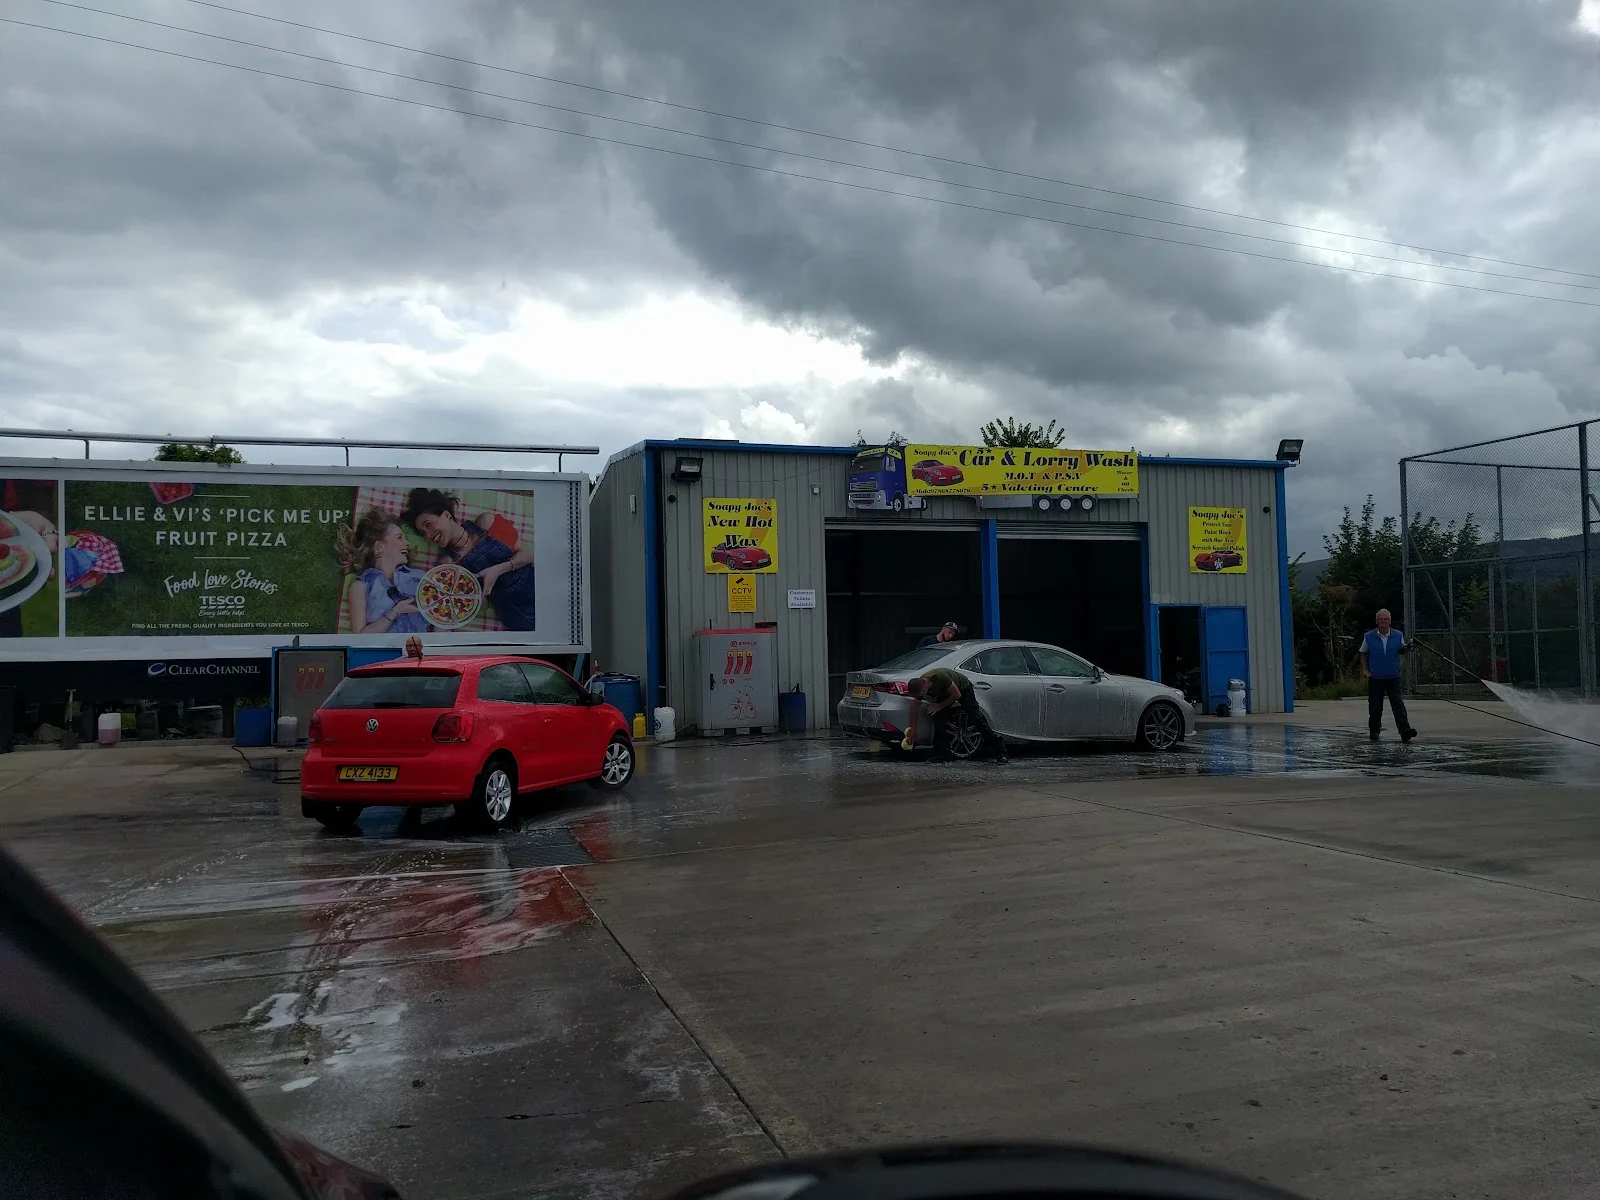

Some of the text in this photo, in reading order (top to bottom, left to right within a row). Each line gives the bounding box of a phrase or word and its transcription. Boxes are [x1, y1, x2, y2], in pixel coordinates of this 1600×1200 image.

[914, 448, 957, 457] Soapy Joe's
[959, 450, 1134, 470] Car & Lorry Wash
[1005, 472, 1036, 480] M.O.T
[1055, 472, 1083, 480] P.S.V
[1001, 484, 1053, 493] Valeting
[1057, 484, 1099, 492] Centre
[708, 502, 772, 513] Soapy Joe's
[84, 505, 145, 521] ELLIE
[153, 506, 167, 522] &
[172, 507, 211, 522] VI’S
[283, 509, 311, 523] ME
[1192, 510, 1243, 520] Soapy Joe's
[708, 516, 773, 527] New Hot
[155, 531, 288, 547] FRUIT PIZZA
[725, 535, 758, 547] Wax
[164, 569, 279, 598] Food Love Stories
[732, 587, 752, 595] CCTV
[199, 596, 245, 605] TESCO
[198, 609, 216, 618] Every
[345, 768, 391, 778] CXZ 4133
